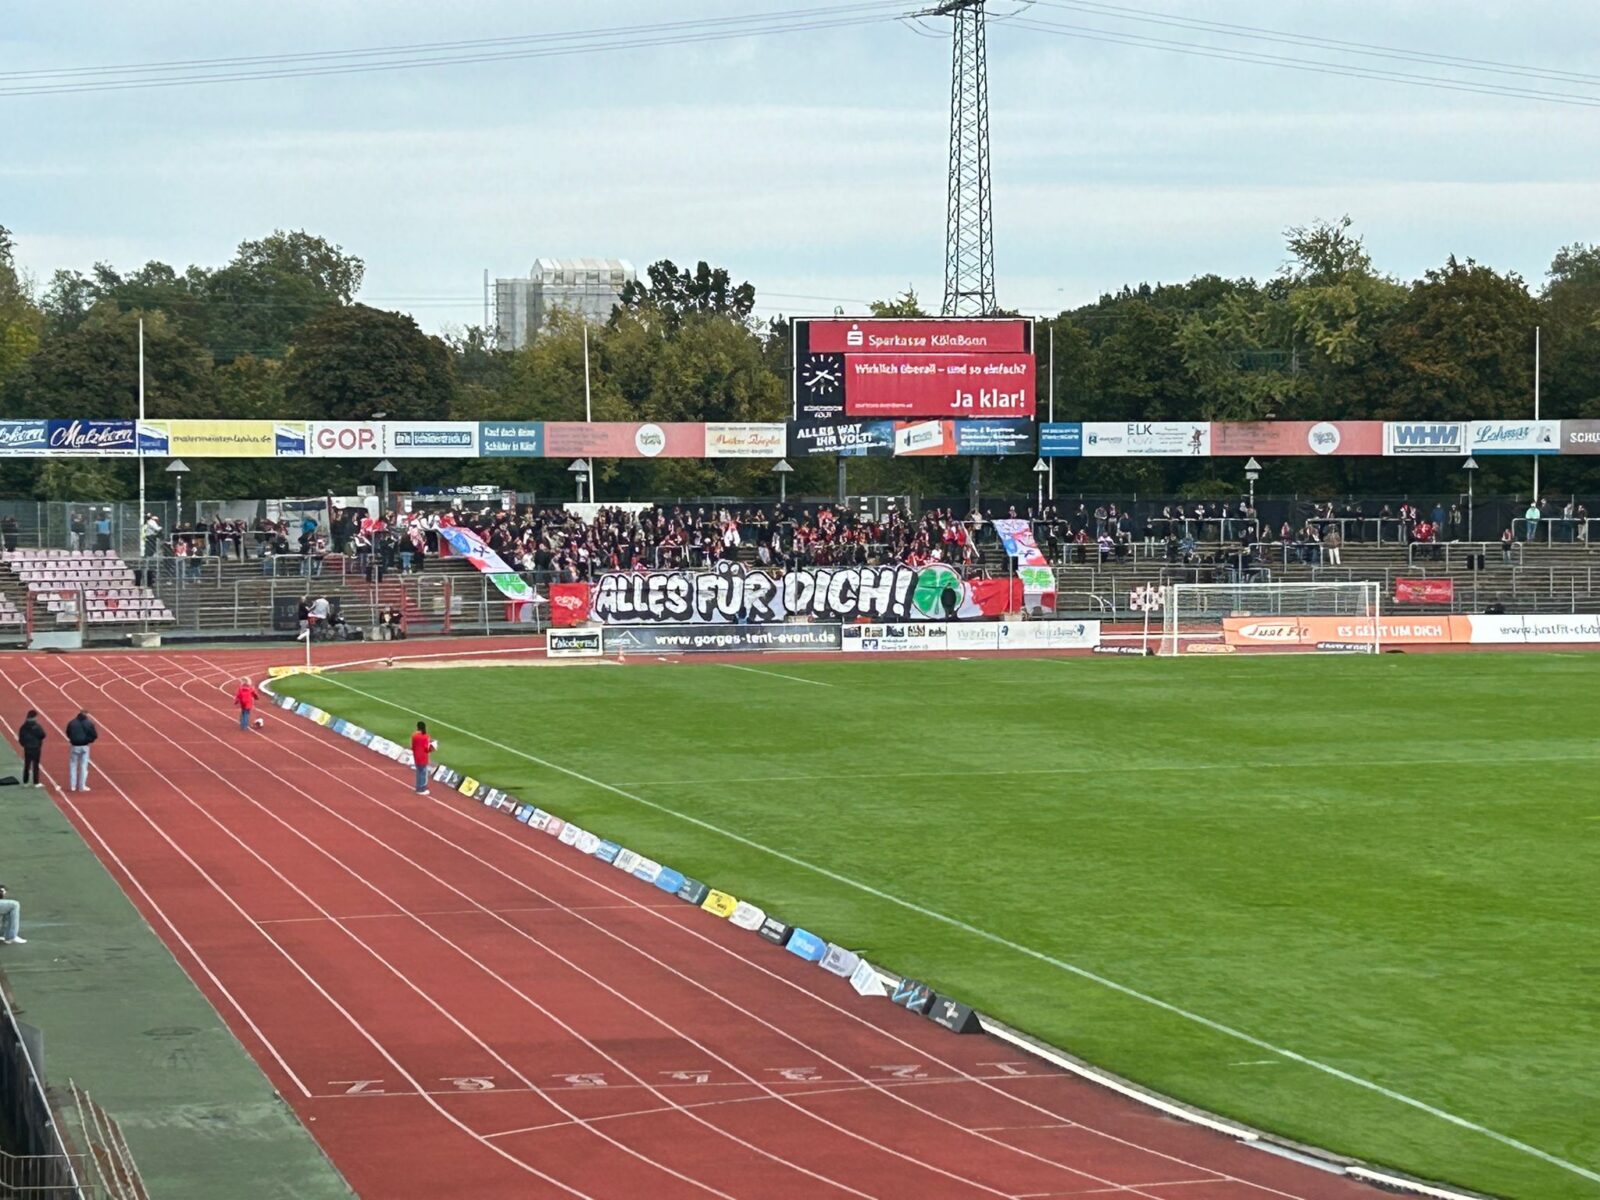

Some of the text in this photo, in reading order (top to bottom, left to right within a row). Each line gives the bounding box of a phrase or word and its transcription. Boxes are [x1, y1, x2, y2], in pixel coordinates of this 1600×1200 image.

[869, 333, 987, 350] Sparkasse KölnBonn
[855, 363, 897, 374] Wirklich
[900, 362, 936, 374] überall
[947, 363, 966, 374] und
[969, 365, 980, 374] so
[983, 363, 1026, 374] einfach?
[951, 388, 1025, 408] Ja klar!
[1127, 424, 1153, 435] ELK
[1396, 425, 1459, 445] WHM
[317, 428, 377, 450] GOP.
[596, 561, 916, 622] ALLES FÜR DICH!
[655, 631, 836, 647] www.gorges-tent-event.de
[1337, 625, 1353, 637] ES
[1390, 625, 1412, 637] UM
[1413, 625, 1442, 637] DICH
